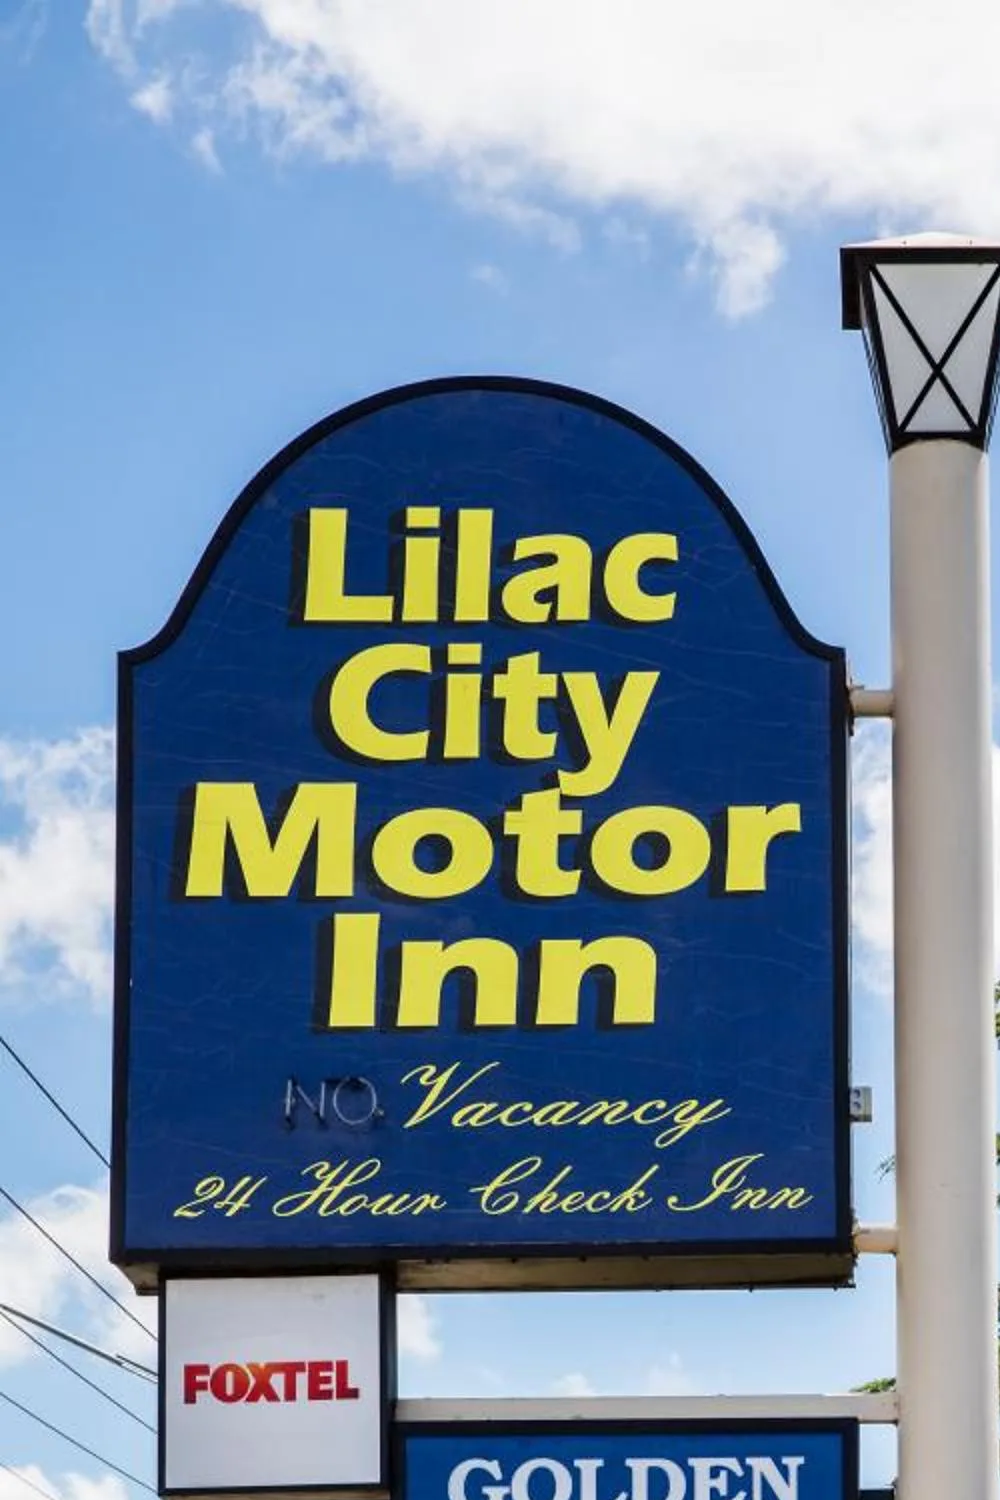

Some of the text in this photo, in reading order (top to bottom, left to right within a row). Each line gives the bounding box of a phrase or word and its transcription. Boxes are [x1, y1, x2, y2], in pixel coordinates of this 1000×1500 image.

[303, 506, 679, 624] Lilac
[329, 643, 661, 797] City
[184, 781, 802, 899] Motor
[328, 912, 658, 1027] Inn
[401, 1061, 731, 1148] Vacancy
[174, 1153, 814, 1219] 24 Hour Check Inn
[183, 1360, 360, 1404] FOXTEL
